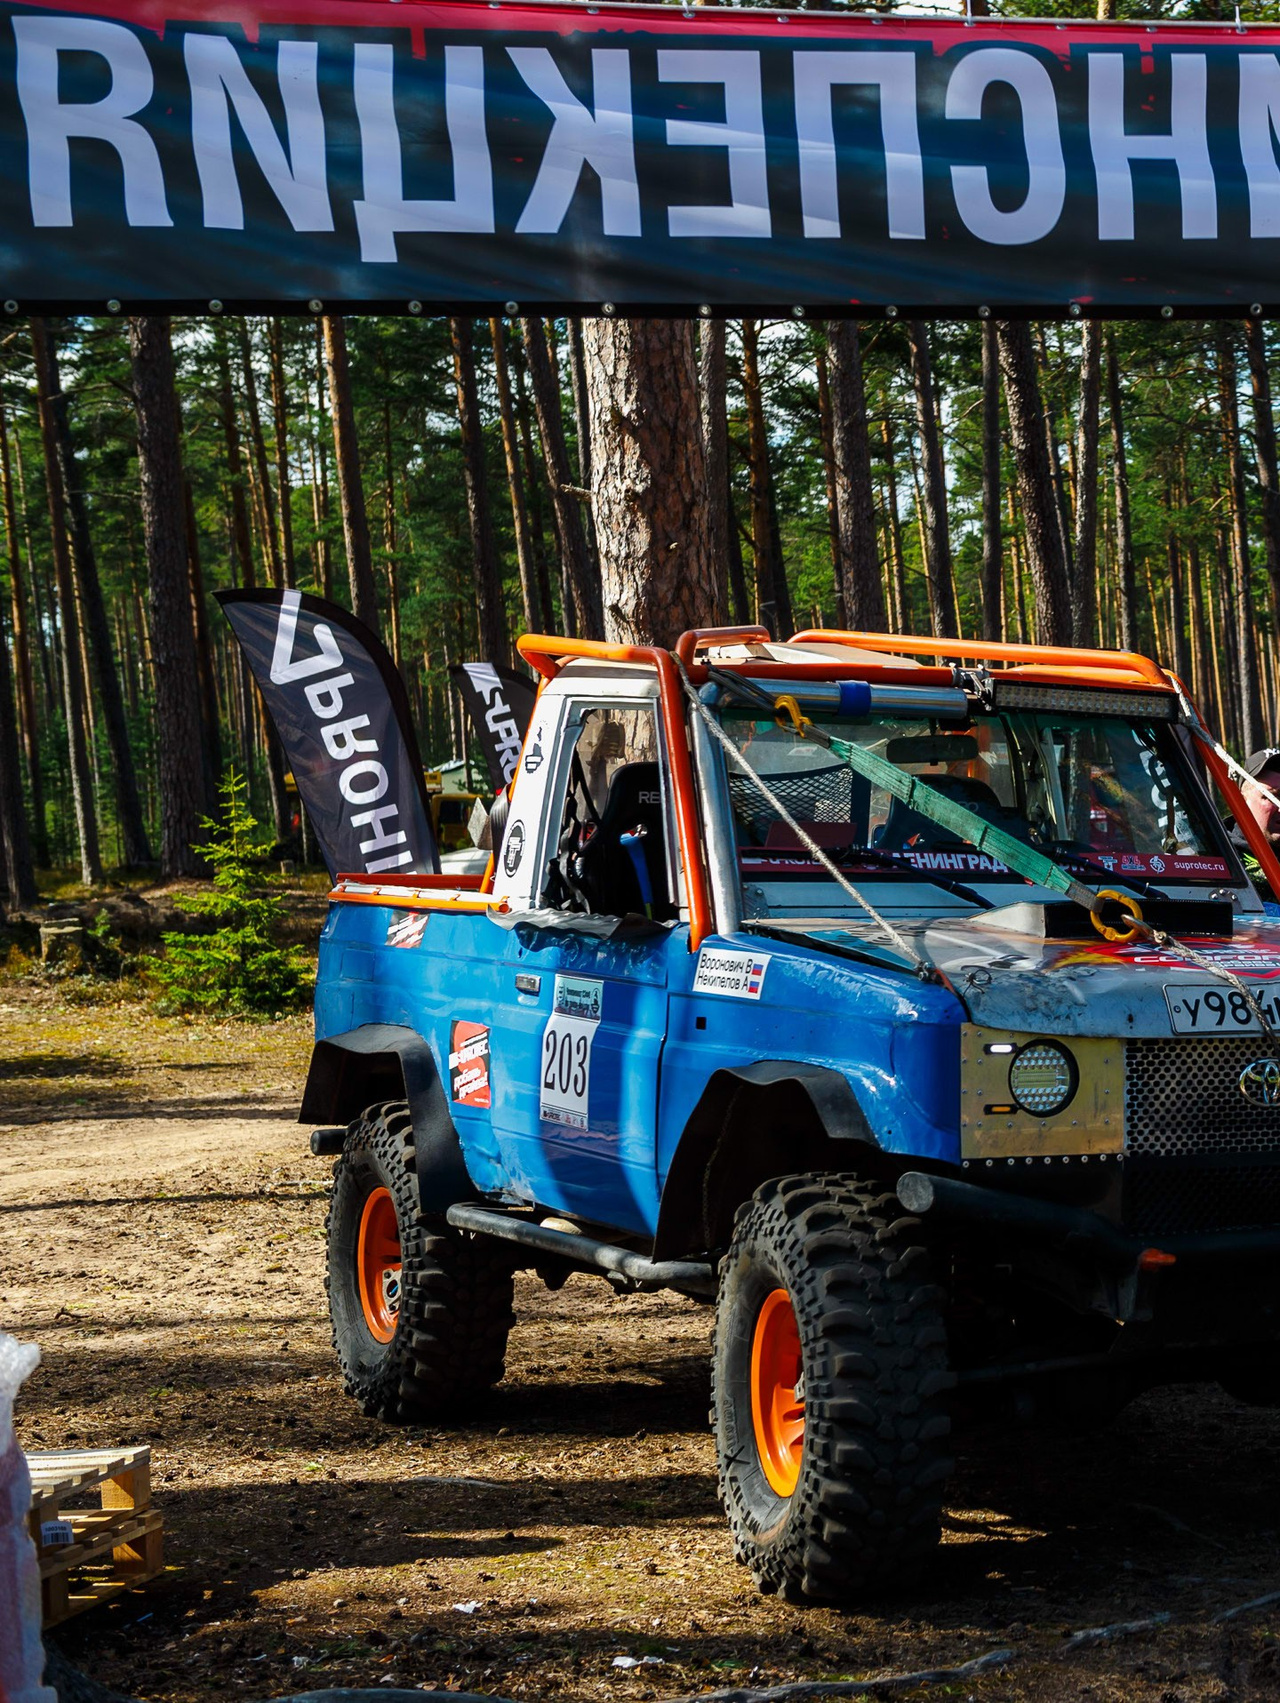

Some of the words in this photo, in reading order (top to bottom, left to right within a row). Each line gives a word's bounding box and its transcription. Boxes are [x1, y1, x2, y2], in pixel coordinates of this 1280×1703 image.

[1173, 861, 1225, 871] suprotec.ru
[700, 953, 745, 974] Воронович
[696, 970, 741, 990] Некипелов
[543, 1029, 588, 1098] 203
